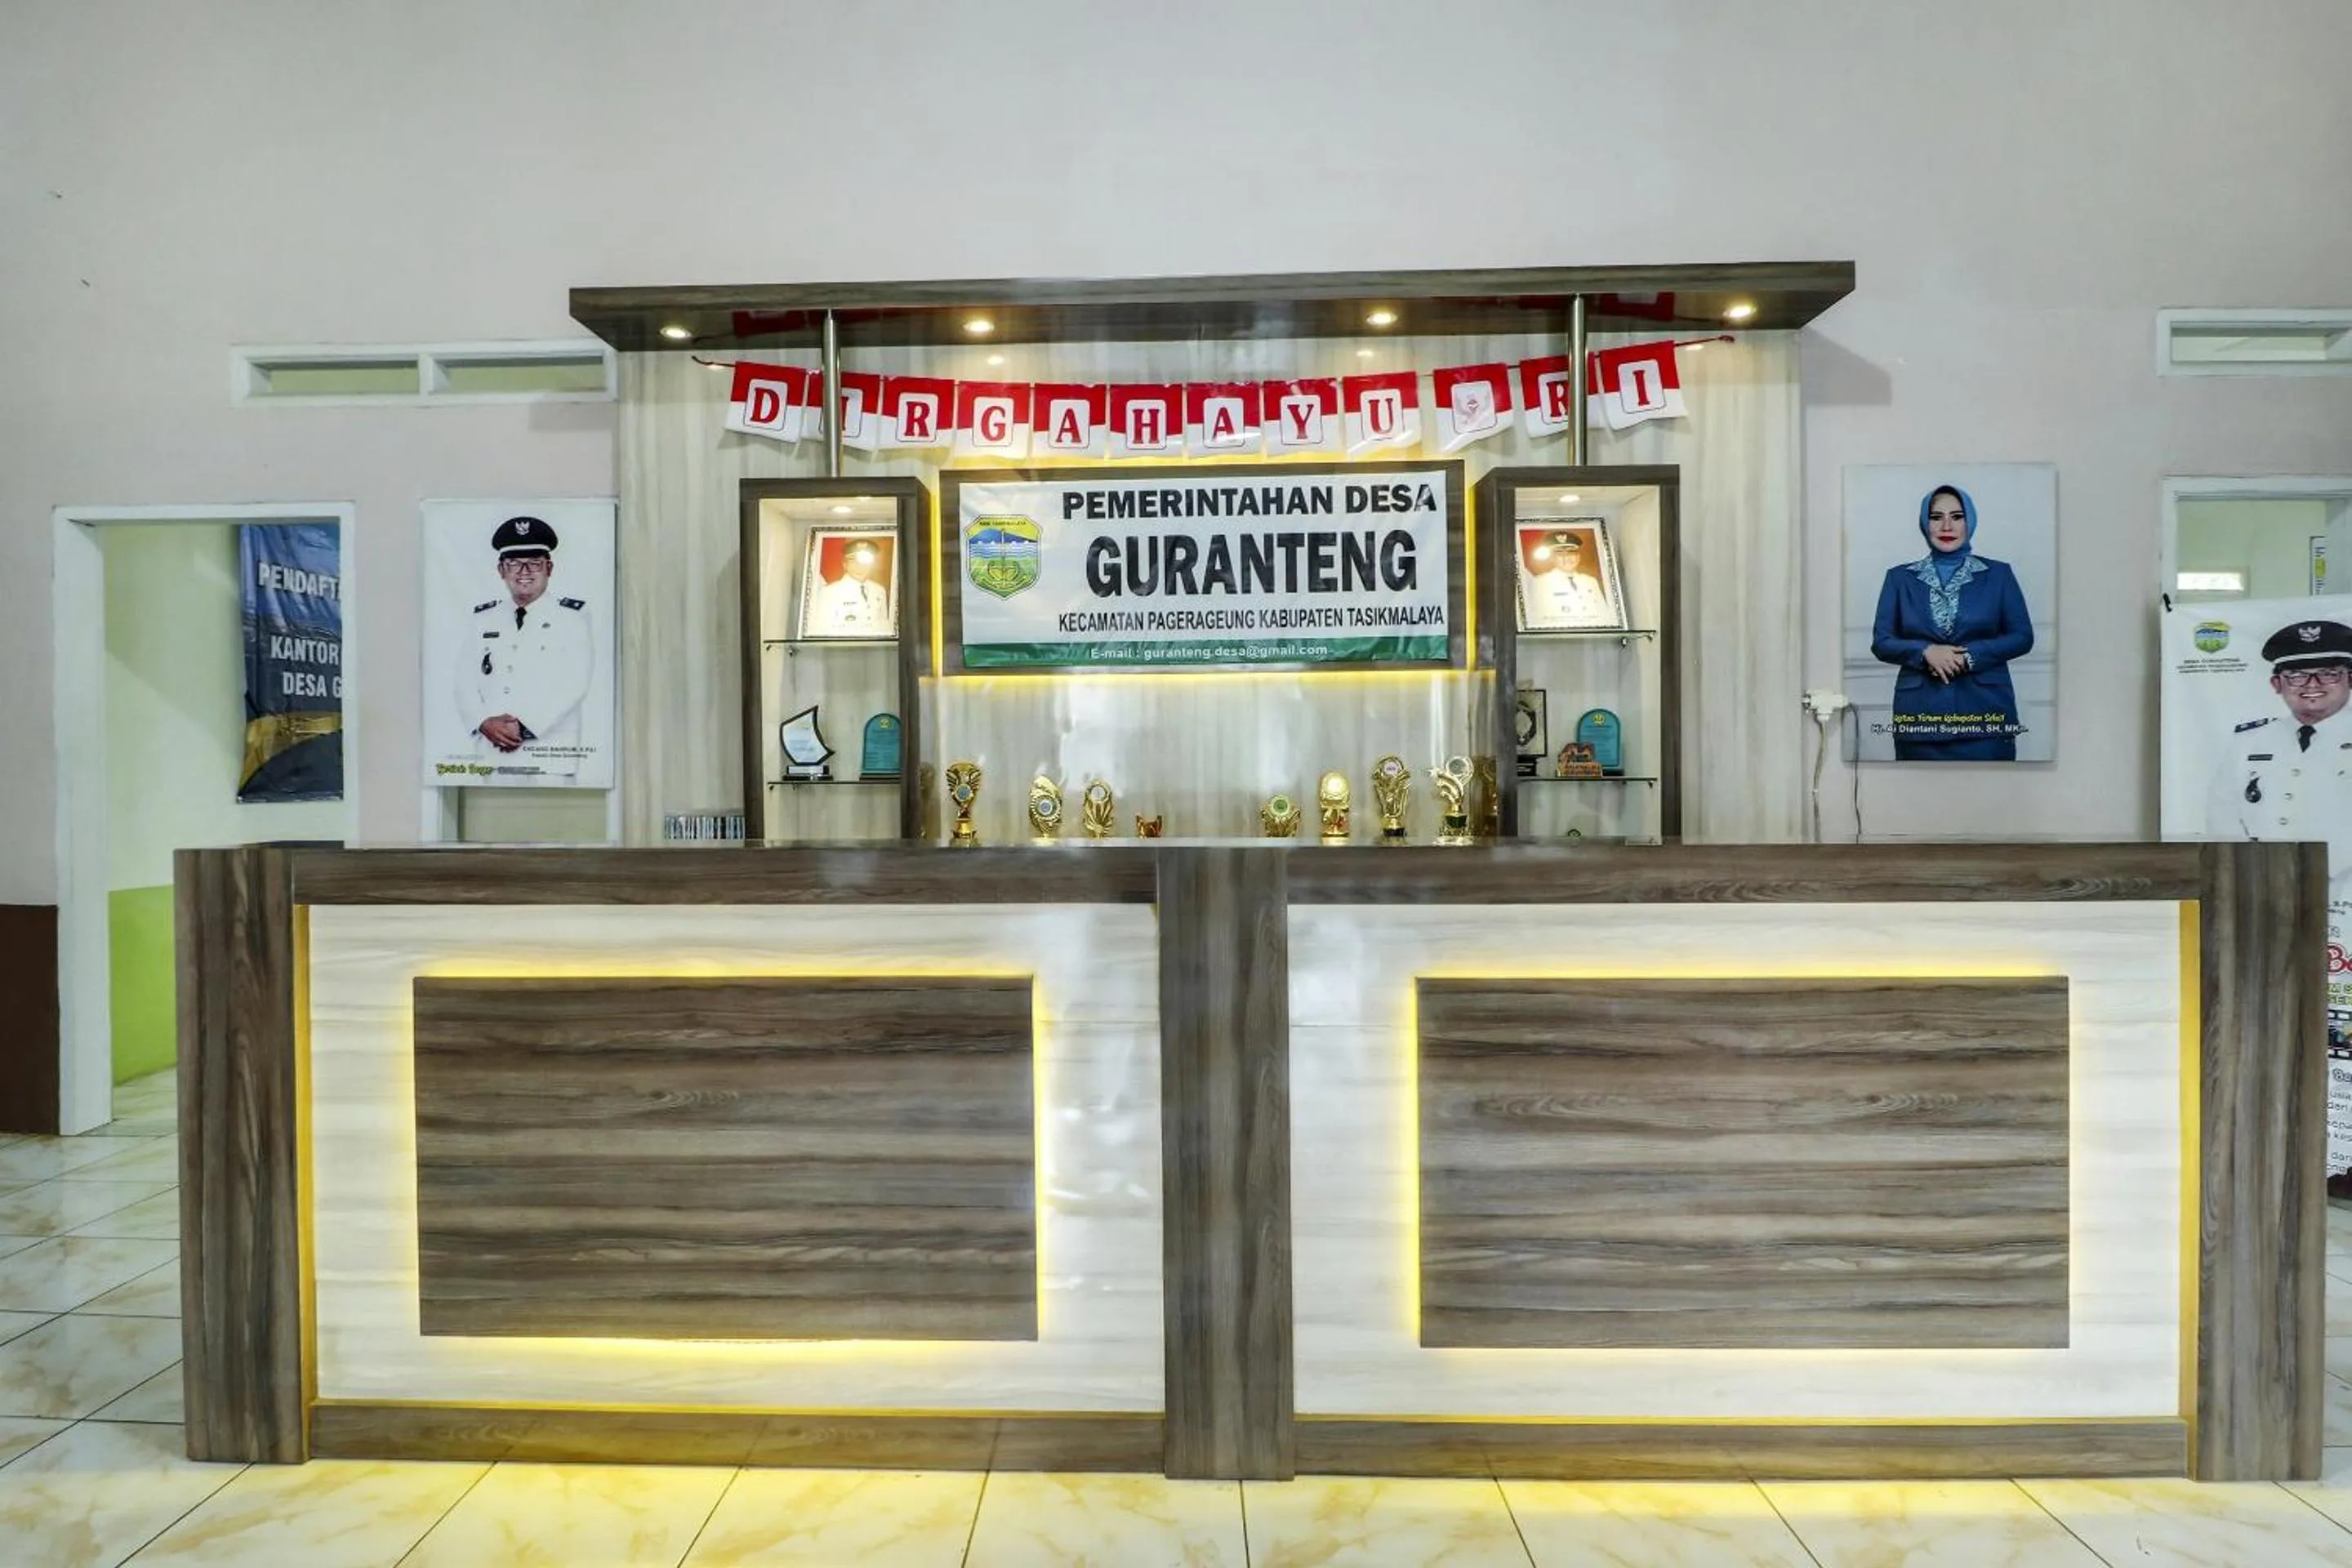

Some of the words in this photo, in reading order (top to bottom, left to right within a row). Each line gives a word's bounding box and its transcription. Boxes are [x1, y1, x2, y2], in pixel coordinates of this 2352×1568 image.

[1062, 485, 1334, 519] PEMERINTAHAN
[1346, 483, 1437, 514] DESA
[1085, 529, 1417, 598] GURANTENG
[258, 562, 341, 600] PENDAFT
[1058, 611, 1143, 632] KECAMATAN
[1148, 609, 1255, 630] PAGERAGEUNG
[1259, 608, 1343, 629] KABUPATEN
[1348, 604, 1445, 627] TASIKMALAYA
[270, 635, 339, 666] KANTOR
[1090, 648, 1133, 660] E-mail
[283, 671, 327, 697] DESA
